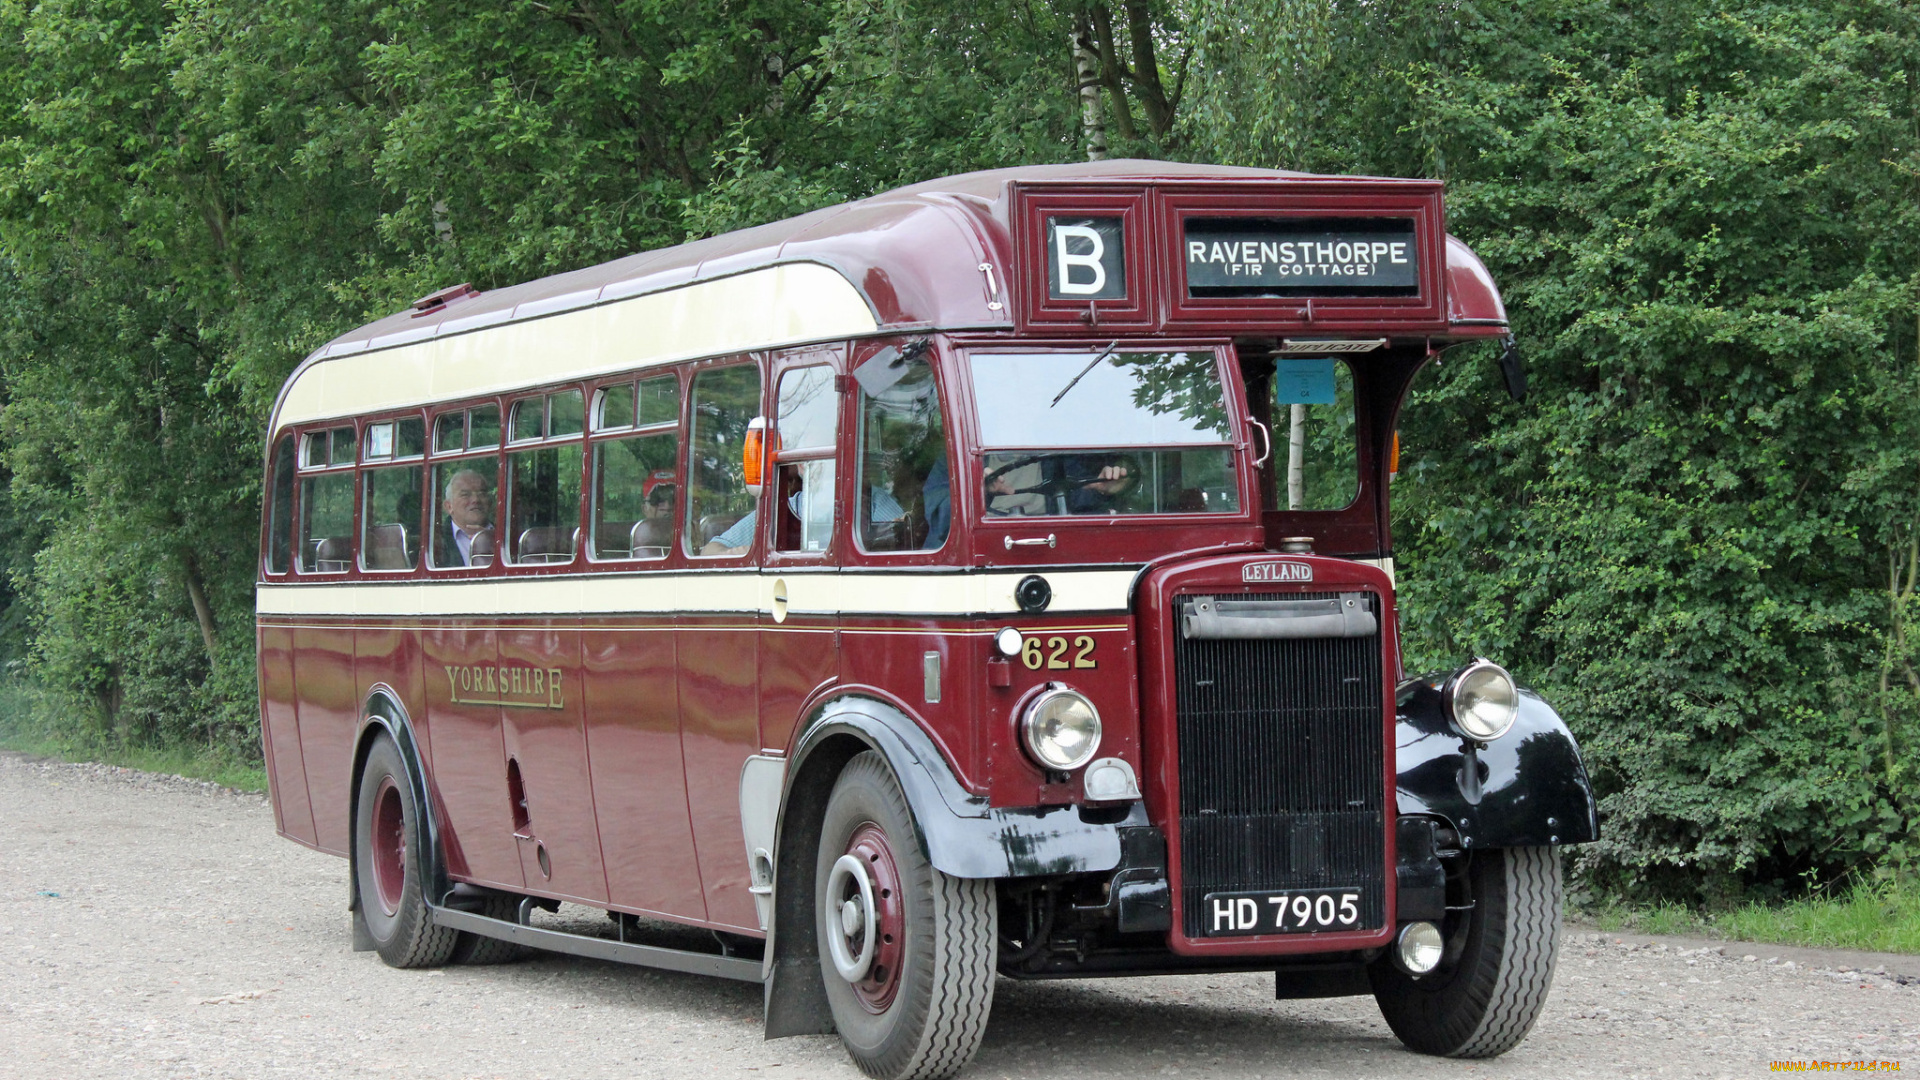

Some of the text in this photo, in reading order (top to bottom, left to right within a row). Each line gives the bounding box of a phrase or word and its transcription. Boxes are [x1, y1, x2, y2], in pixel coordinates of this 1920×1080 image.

[1055, 225, 1105, 294] B
[1189, 241, 1408, 264] RAVENSTHORPE
[1224, 263, 1376, 276] (FIR COTTAGE)
[1245, 564, 1311, 580] LEYLAND
[1021, 635, 1097, 670] 622
[444, 665, 564, 709] YORKSHIRE
[1213, 893, 1359, 931] HD 7905
